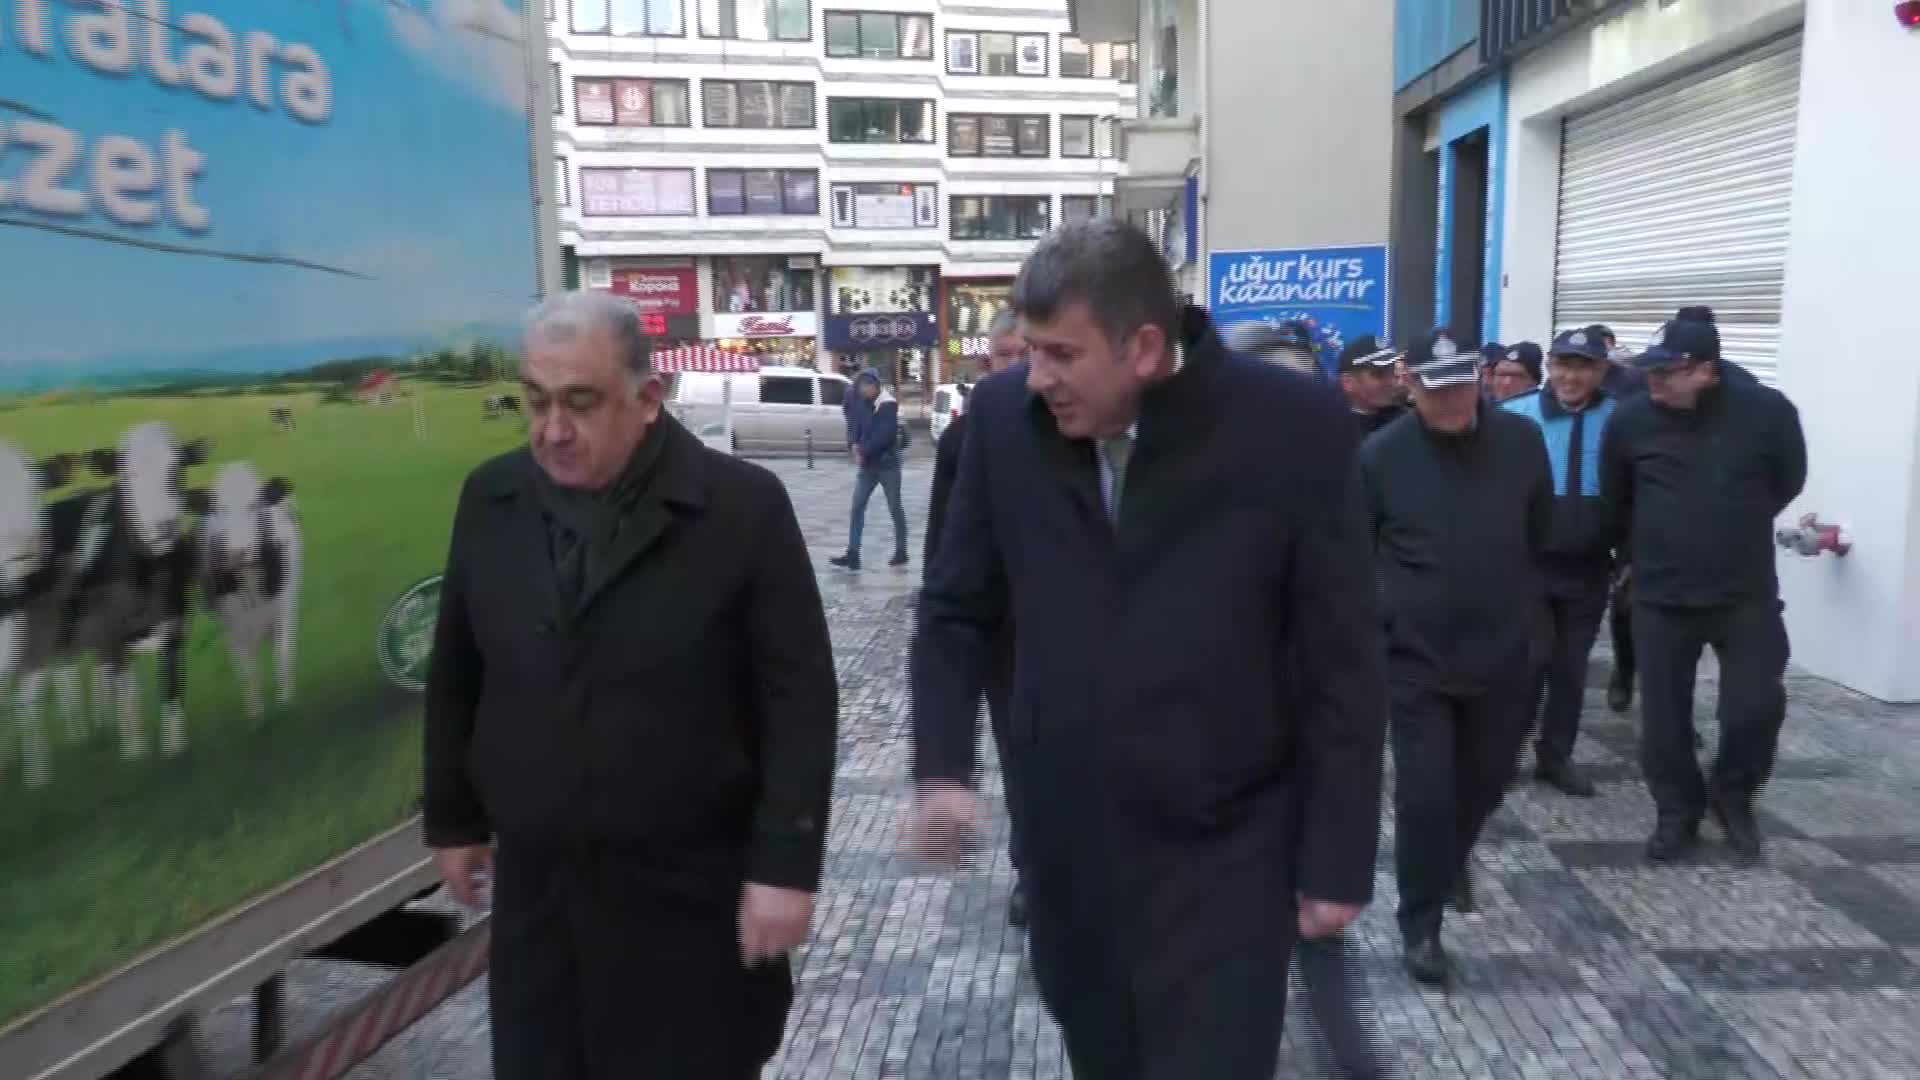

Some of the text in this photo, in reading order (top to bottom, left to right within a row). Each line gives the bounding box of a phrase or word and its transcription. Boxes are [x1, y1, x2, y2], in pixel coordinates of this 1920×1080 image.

[0, 117, 211, 232] zet
[1227, 253, 1364, 284] uğur kurs
